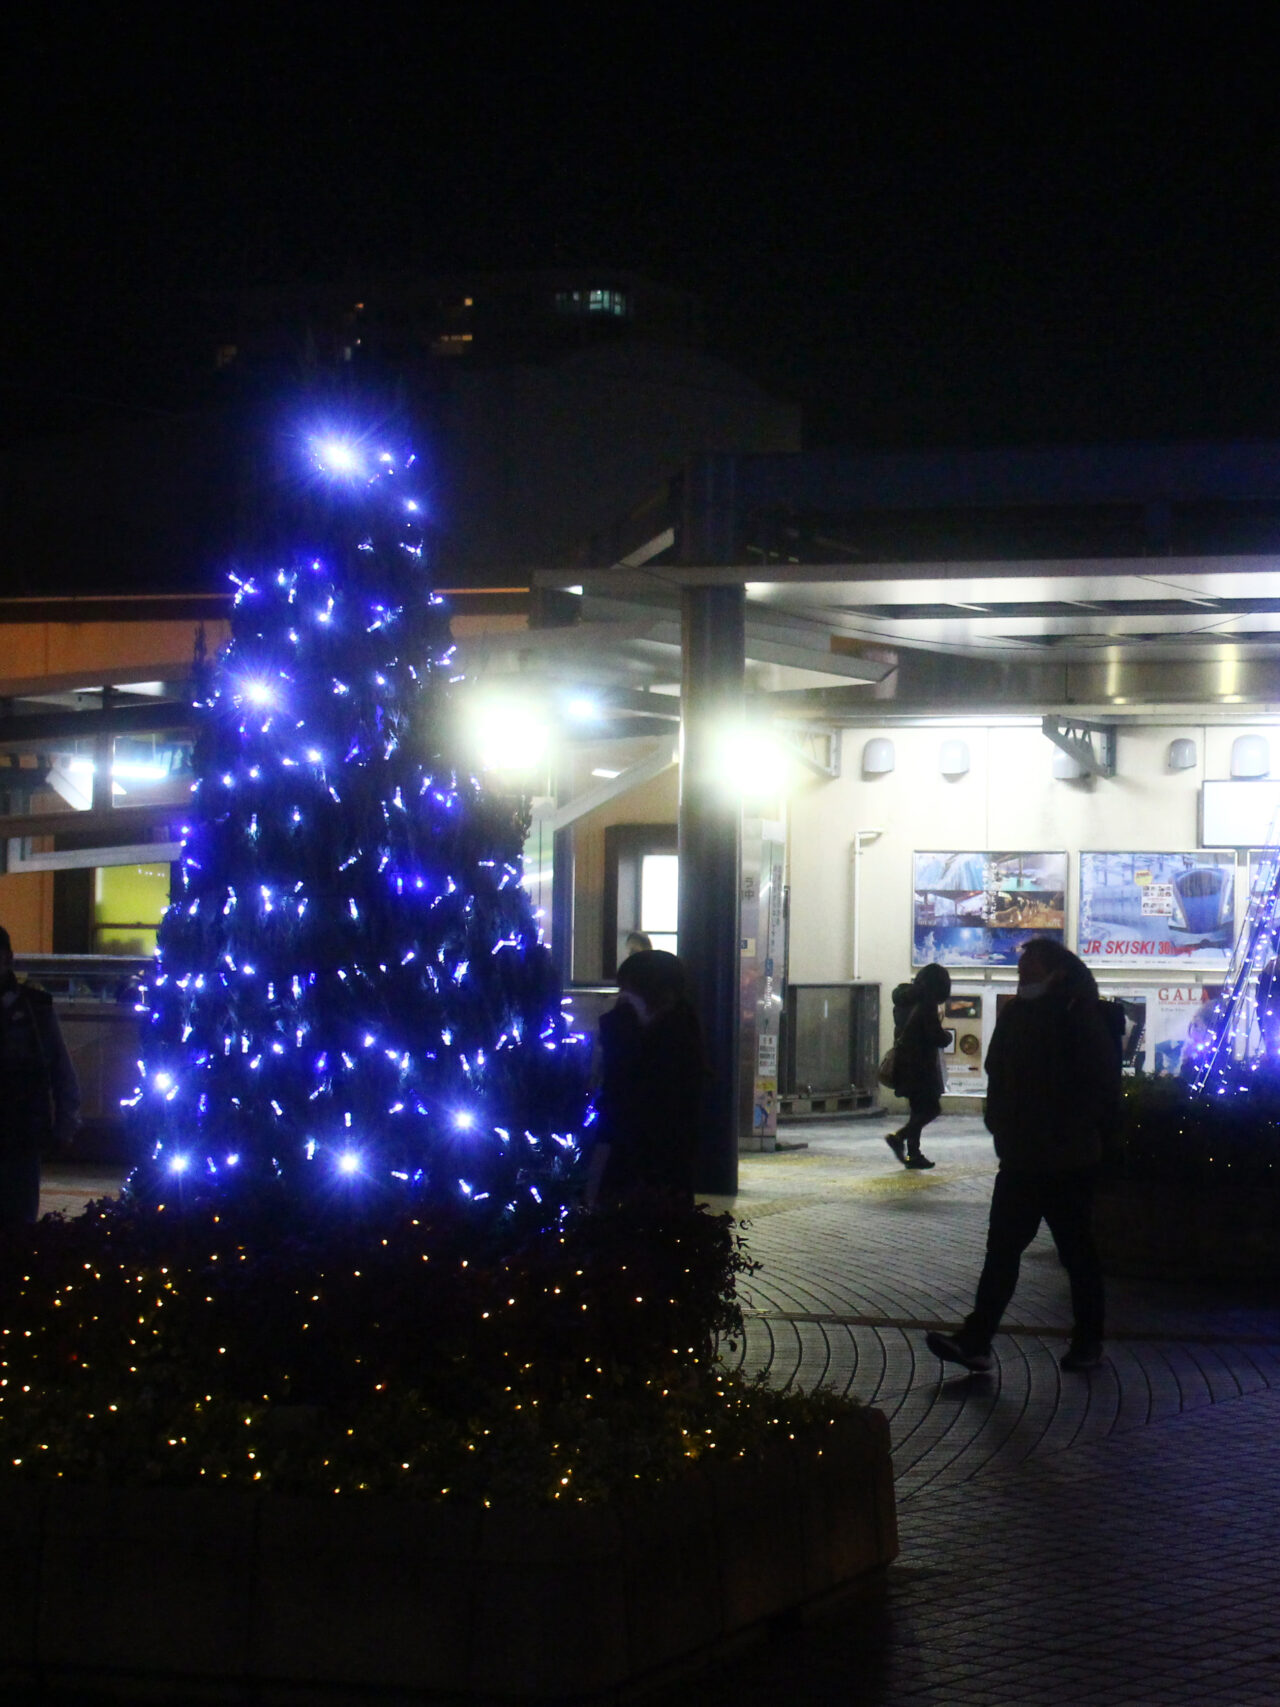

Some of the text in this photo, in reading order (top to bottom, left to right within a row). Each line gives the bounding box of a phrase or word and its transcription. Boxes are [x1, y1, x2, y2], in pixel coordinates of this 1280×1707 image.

[1083, 940, 1101, 954] JR
[1105, 941, 1155, 954] SKISKI
[1158, 988, 1209, 1001] GALA
